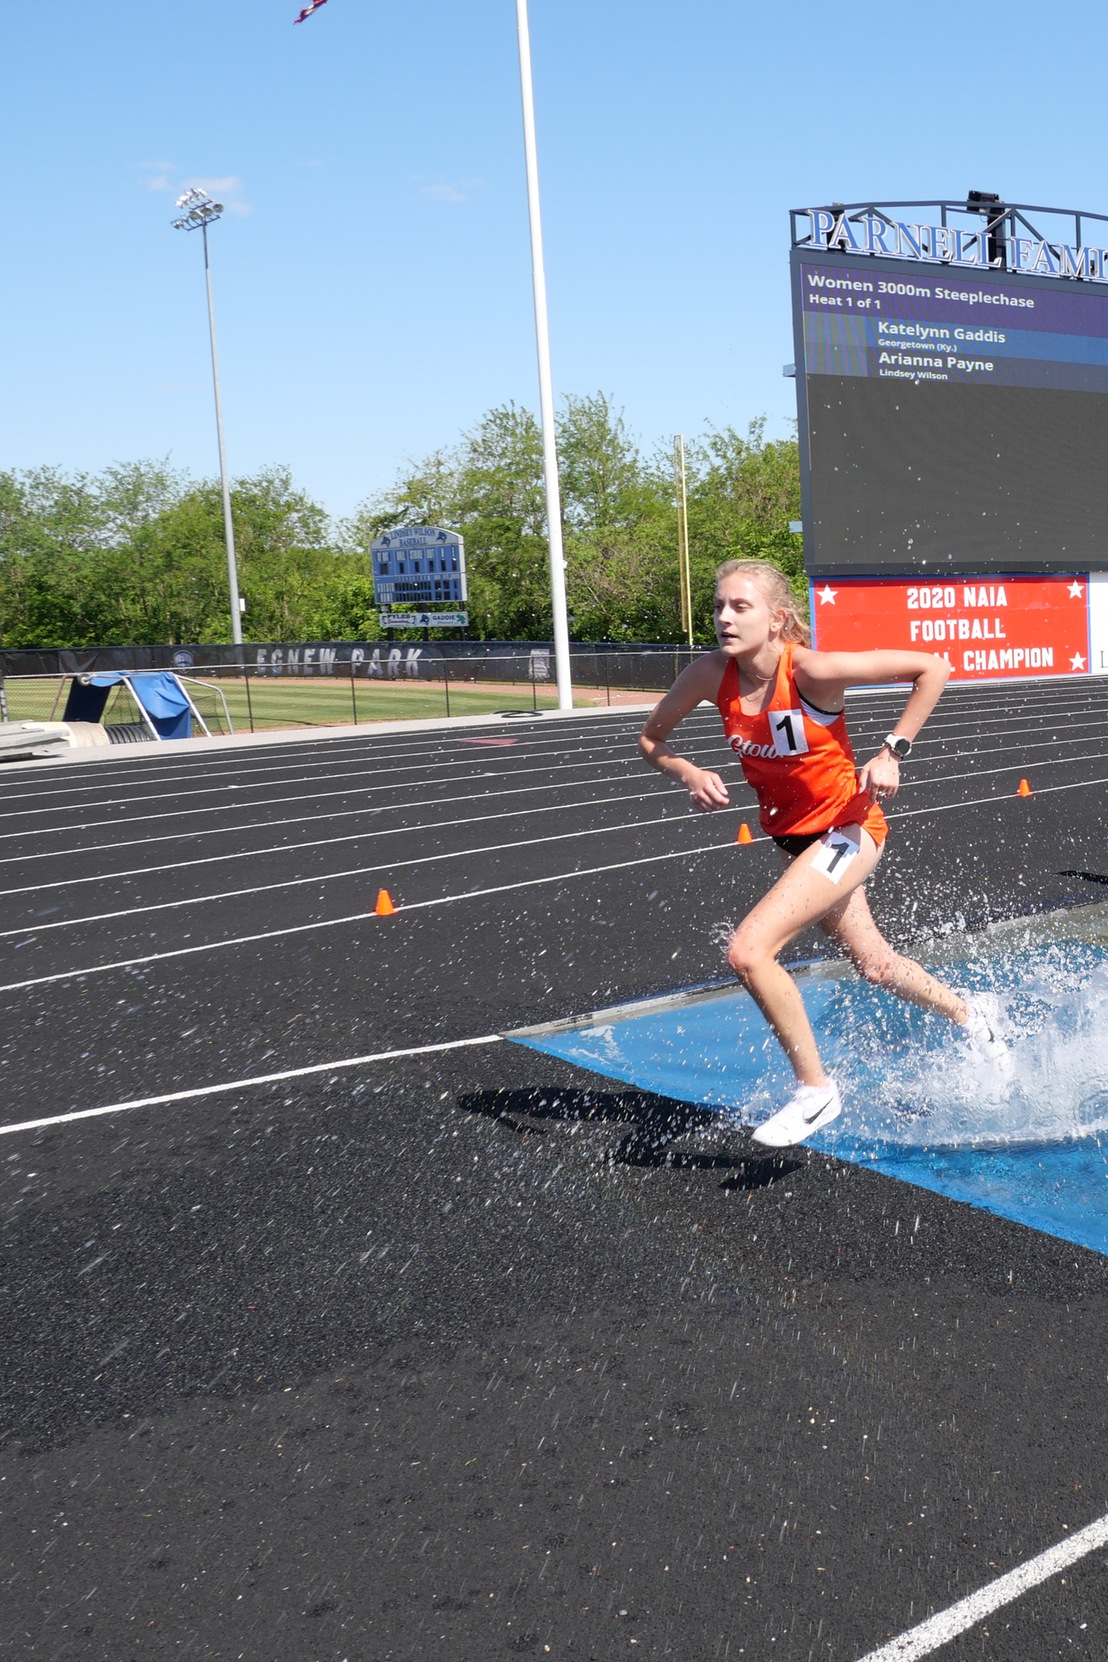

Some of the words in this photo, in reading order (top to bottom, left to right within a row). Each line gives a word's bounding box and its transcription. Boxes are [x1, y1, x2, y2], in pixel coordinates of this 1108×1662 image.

[807, 209, 1002, 268] PARNELL
[808, 275, 873, 292] Women
[878, 281, 930, 298] 3000m
[935, 287, 1035, 308] Steeplechase
[809, 294, 842, 306] Heat
[847, 297, 853, 307] 1
[857, 298, 871, 309] of
[875, 300, 881, 309] 1
[878, 321, 949, 340] Katelynn
[954, 328, 1006, 343] Gaddis
[878, 338, 935, 350] Georgetown
[937, 342, 957, 353] (Ky.)
[878, 352, 943, 367] Arianna
[948, 356, 994, 372] Payne
[879, 368, 915, 380] Lindsey
[917, 371, 948, 380] Wilson
[907, 587, 955, 609] 2020
[963, 586, 1008, 607] NAIA
[910, 618, 1006, 641] FOOTBALL
[351, 648, 424, 677] PARK
[963, 647, 1054, 671] CHAMPION
[776, 715, 797, 751] 1
[728, 734, 784, 759] Gtow
[826, 842, 850, 873] 1
